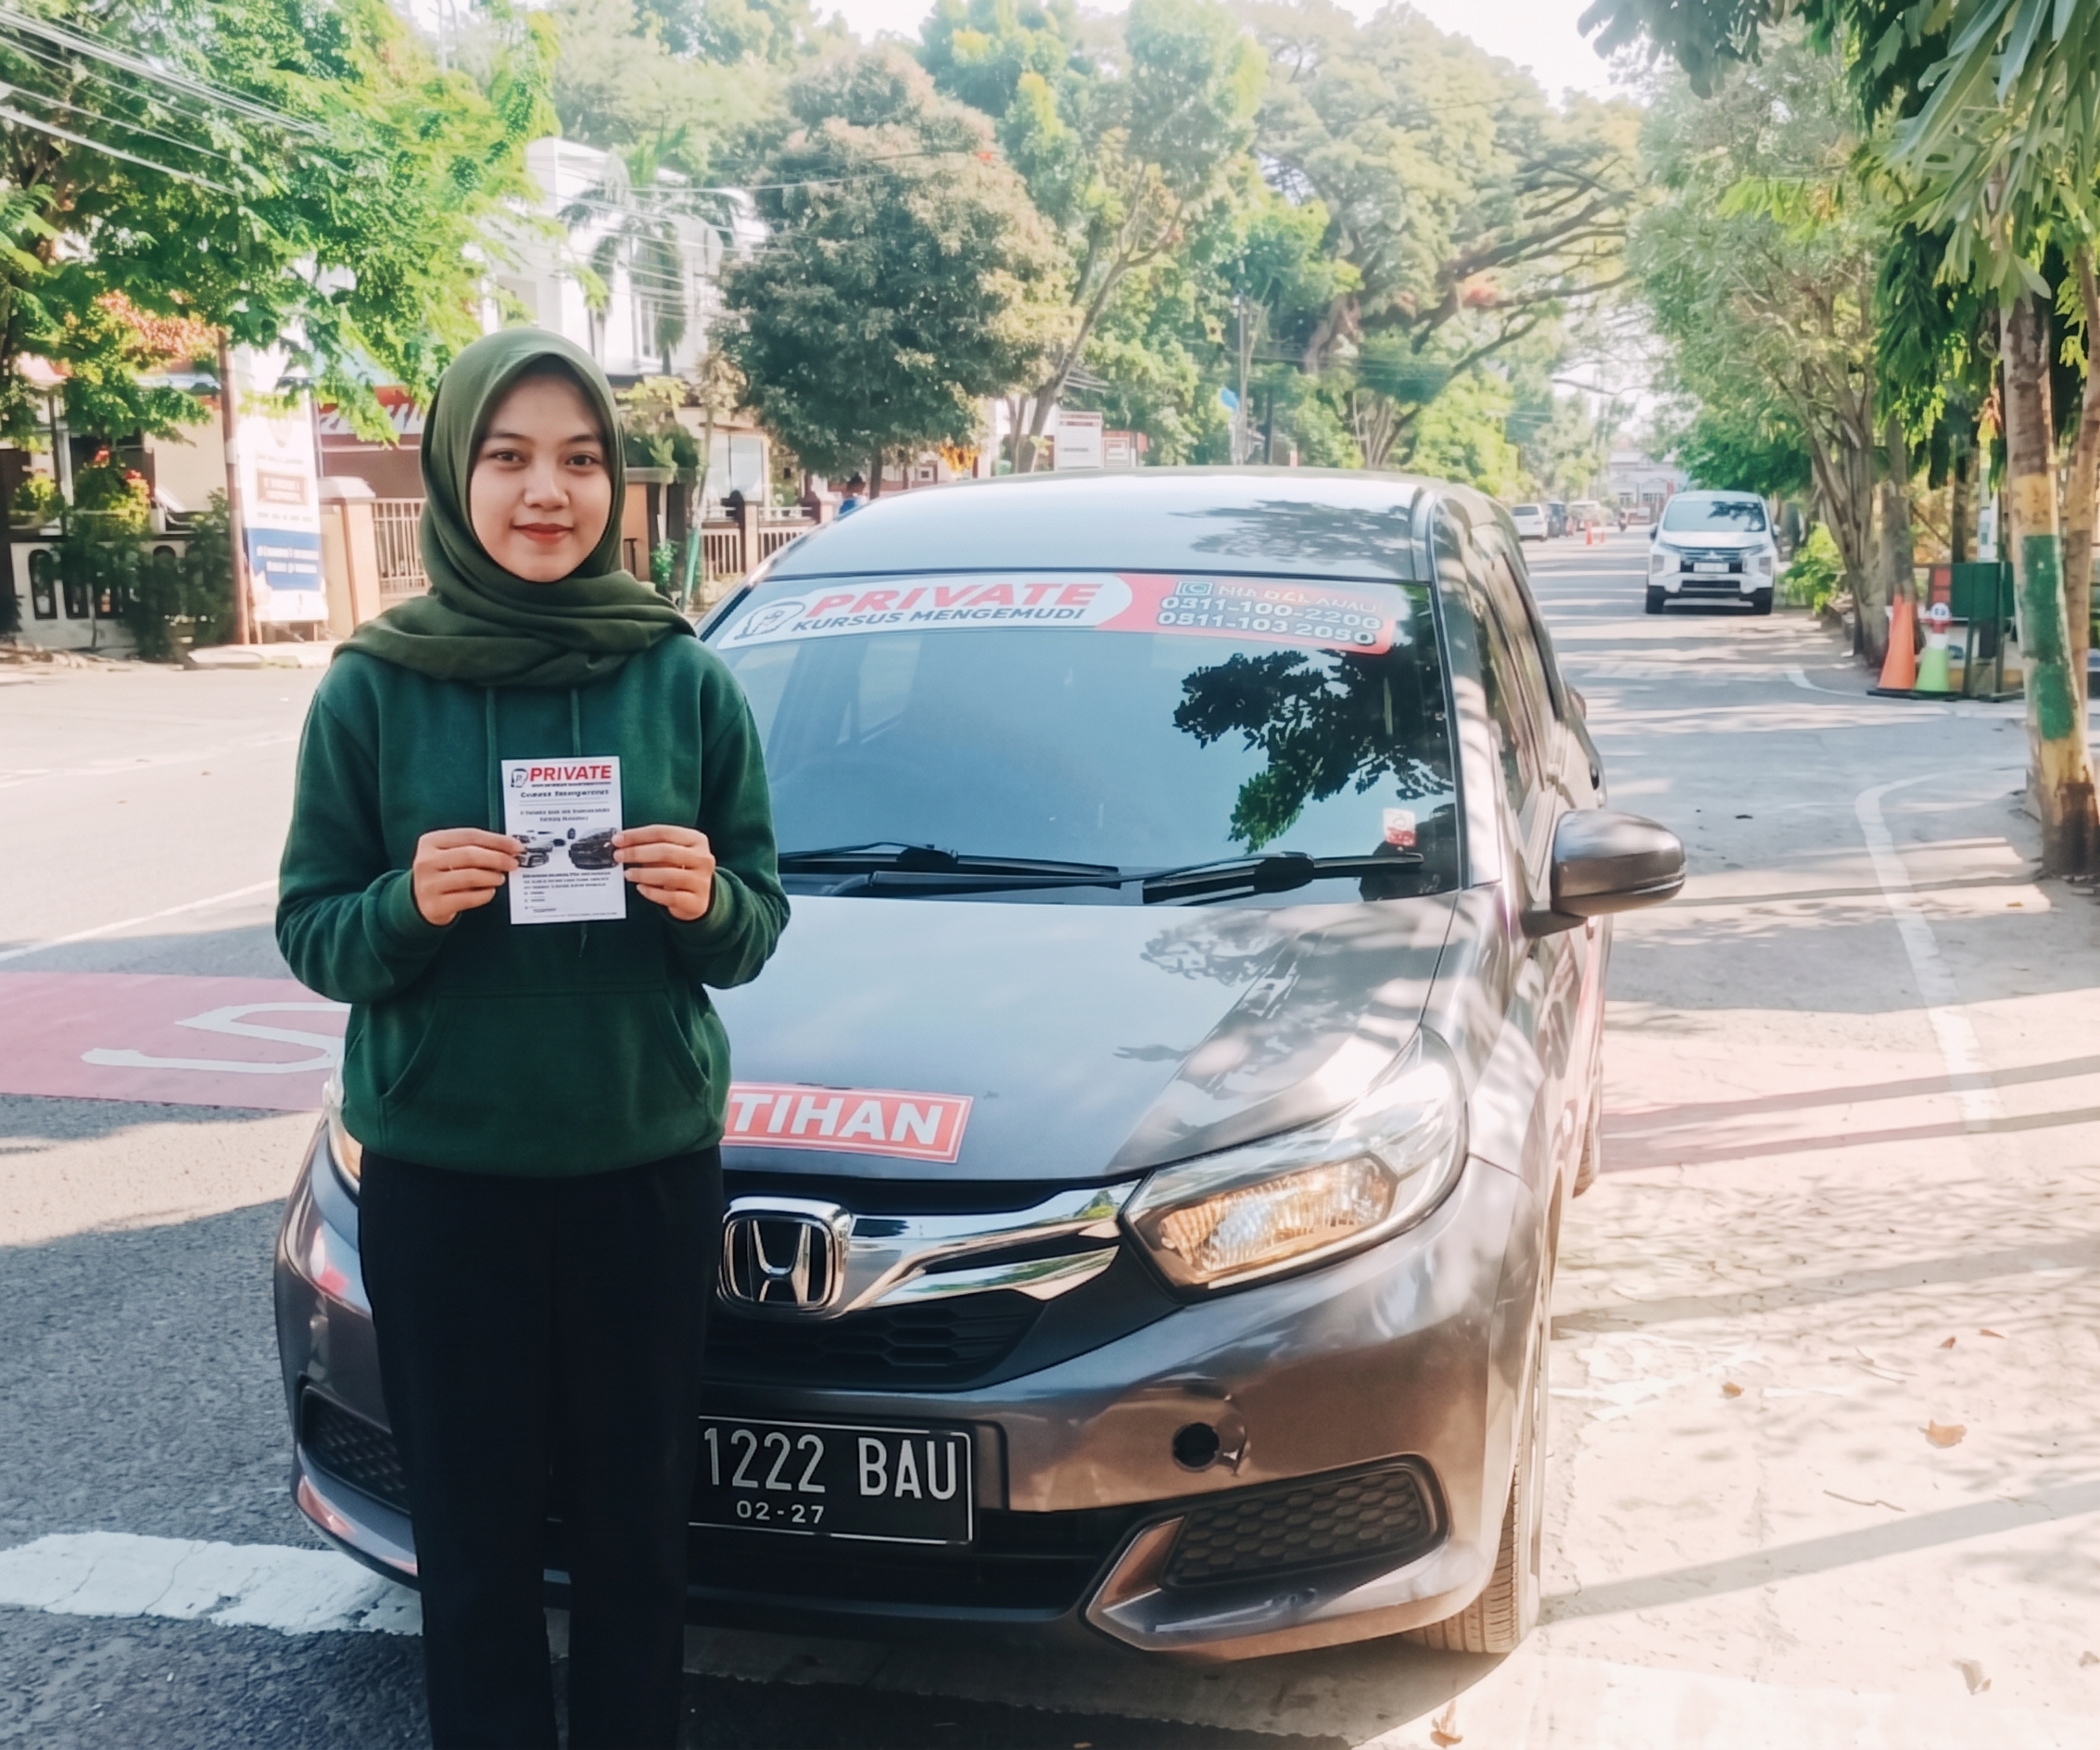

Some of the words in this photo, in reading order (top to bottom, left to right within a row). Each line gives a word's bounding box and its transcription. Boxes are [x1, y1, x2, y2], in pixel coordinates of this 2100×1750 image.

[804, 582, 1104, 618] PRIVATE
[791, 611, 901, 632] KURSUS
[909, 607, 1086, 622] MENGEMUDI
[529, 765, 613, 782] PRIVATE
[703, 1427, 826, 1494] 1222
[857, 1437, 957, 1501] BAU
[736, 1500, 825, 1524] 02-27
